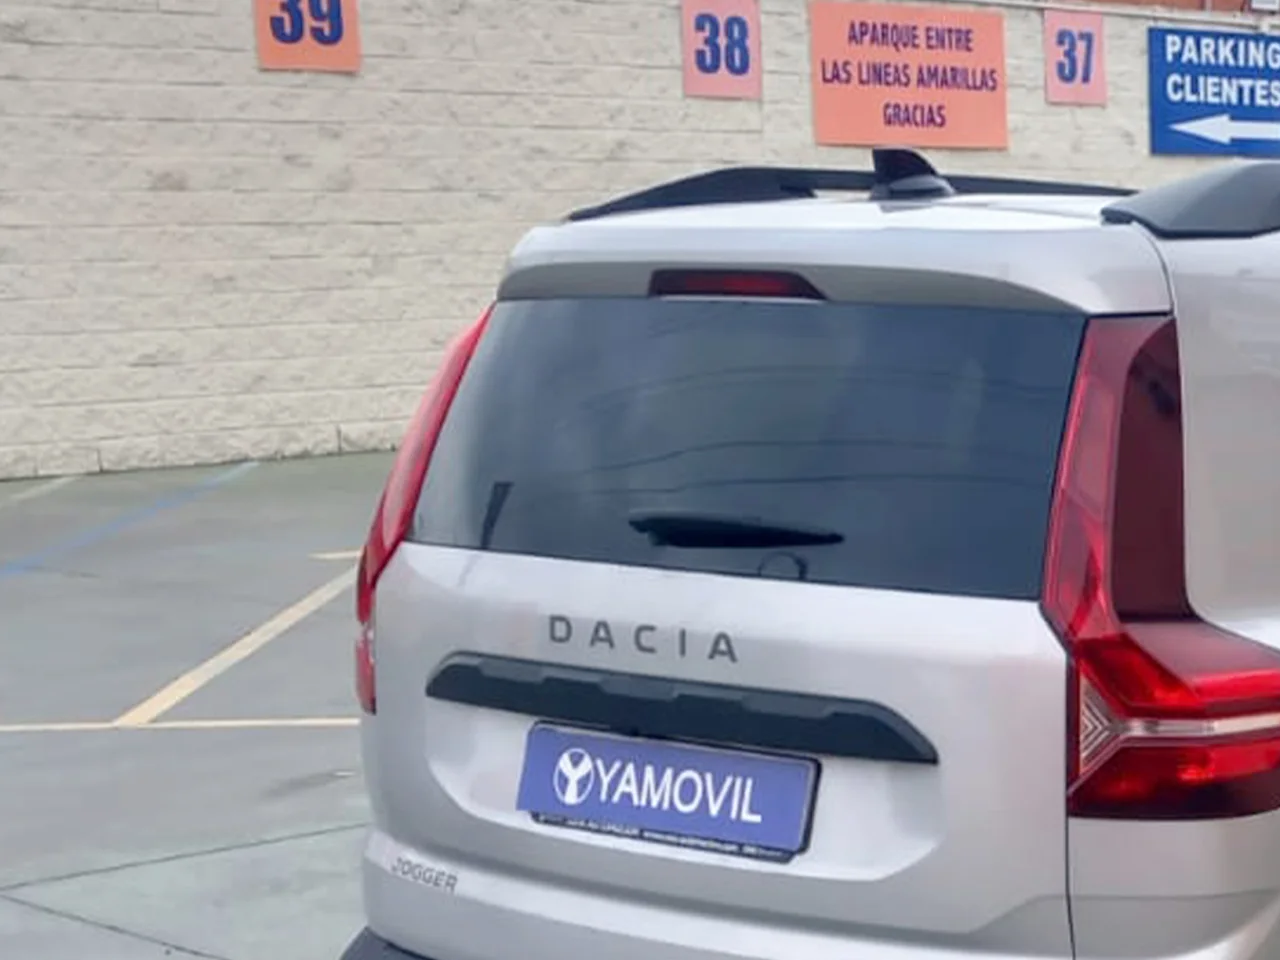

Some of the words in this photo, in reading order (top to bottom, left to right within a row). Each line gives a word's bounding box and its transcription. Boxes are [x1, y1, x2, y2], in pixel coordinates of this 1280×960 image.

[694, 13, 750, 76] 38
[848, 20, 920, 51] APARQUE
[925, 26, 974, 52] ENTRE
[1056, 29, 1094, 84] 37
[821, 59, 852, 84] LAS
[857, 61, 911, 88] LINEAS
[917, 64, 998, 91] AMARILLAS
[883, 102, 946, 128] GRACIAS
[548, 614, 739, 664] DACIA
[594, 757, 763, 824] YAMOVIL
[391, 856, 459, 893] JOGGER
